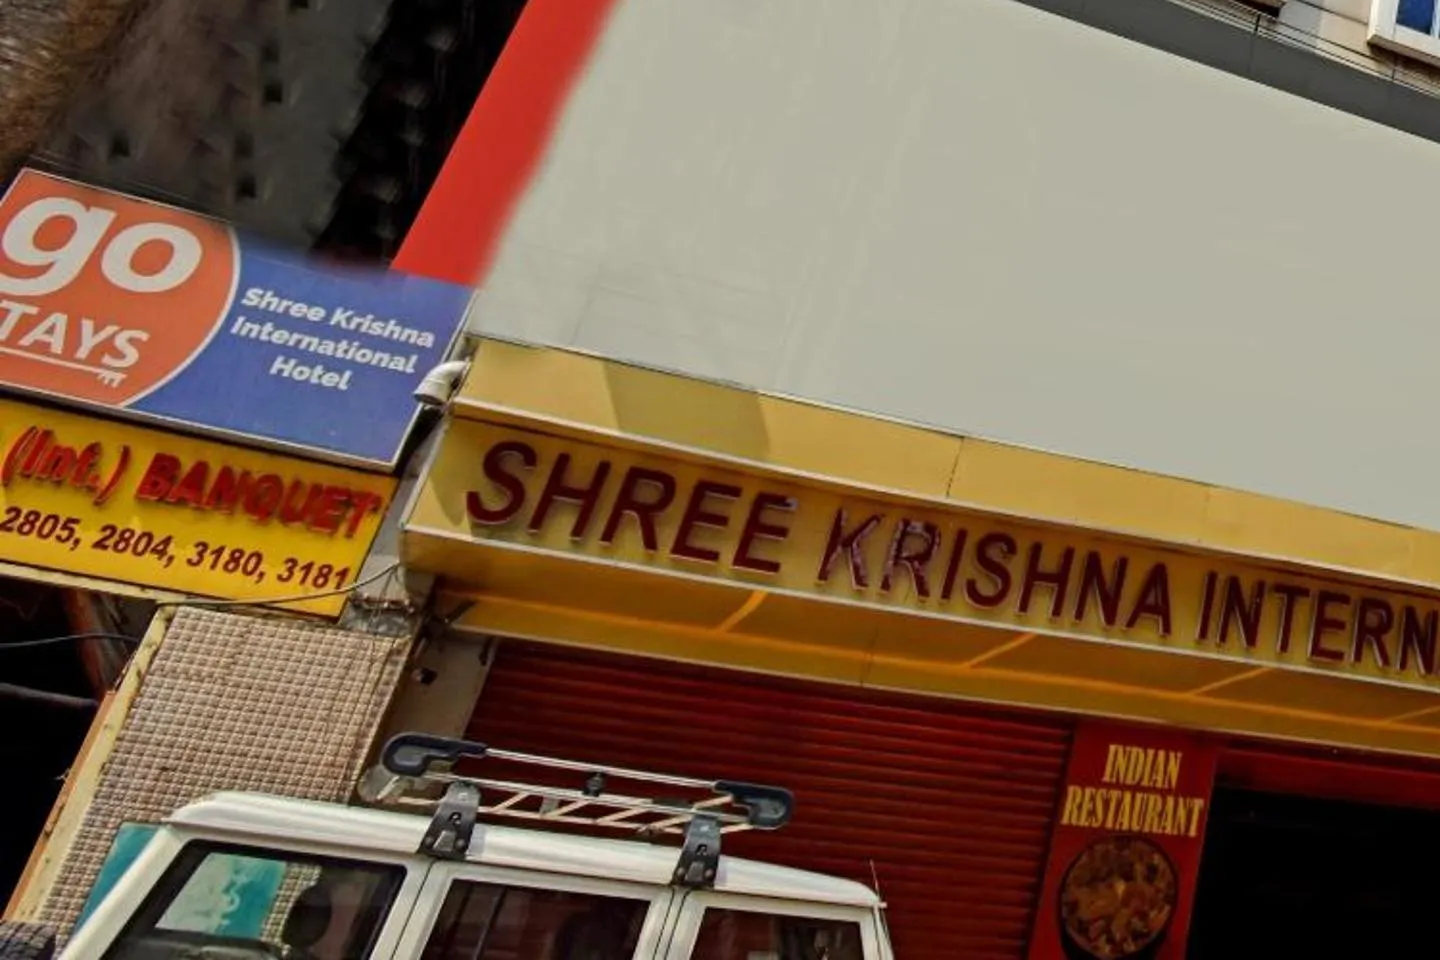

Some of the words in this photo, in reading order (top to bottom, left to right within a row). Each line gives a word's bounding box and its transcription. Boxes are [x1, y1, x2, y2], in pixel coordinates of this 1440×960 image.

[0, 196, 203, 296] go
[230, 316, 416, 374] International
[241, 287, 326, 322] Shree
[330, 308, 435, 348] Krishna
[270, 356, 353, 391] Hotel
[135, 452, 382, 538] BANQUET
[0, 507, 81, 551] 2805,
[91, 525, 174, 568] 2804,
[187, 542, 266, 585] 3180,
[277, 558, 349, 592] 3181
[466, 440, 795, 576] SHREE
[817, 506, 1174, 640] KRISHNA
[1102, 744, 1183, 786] INDIAN
[1061, 786, 1205, 838] RESTAURANT
